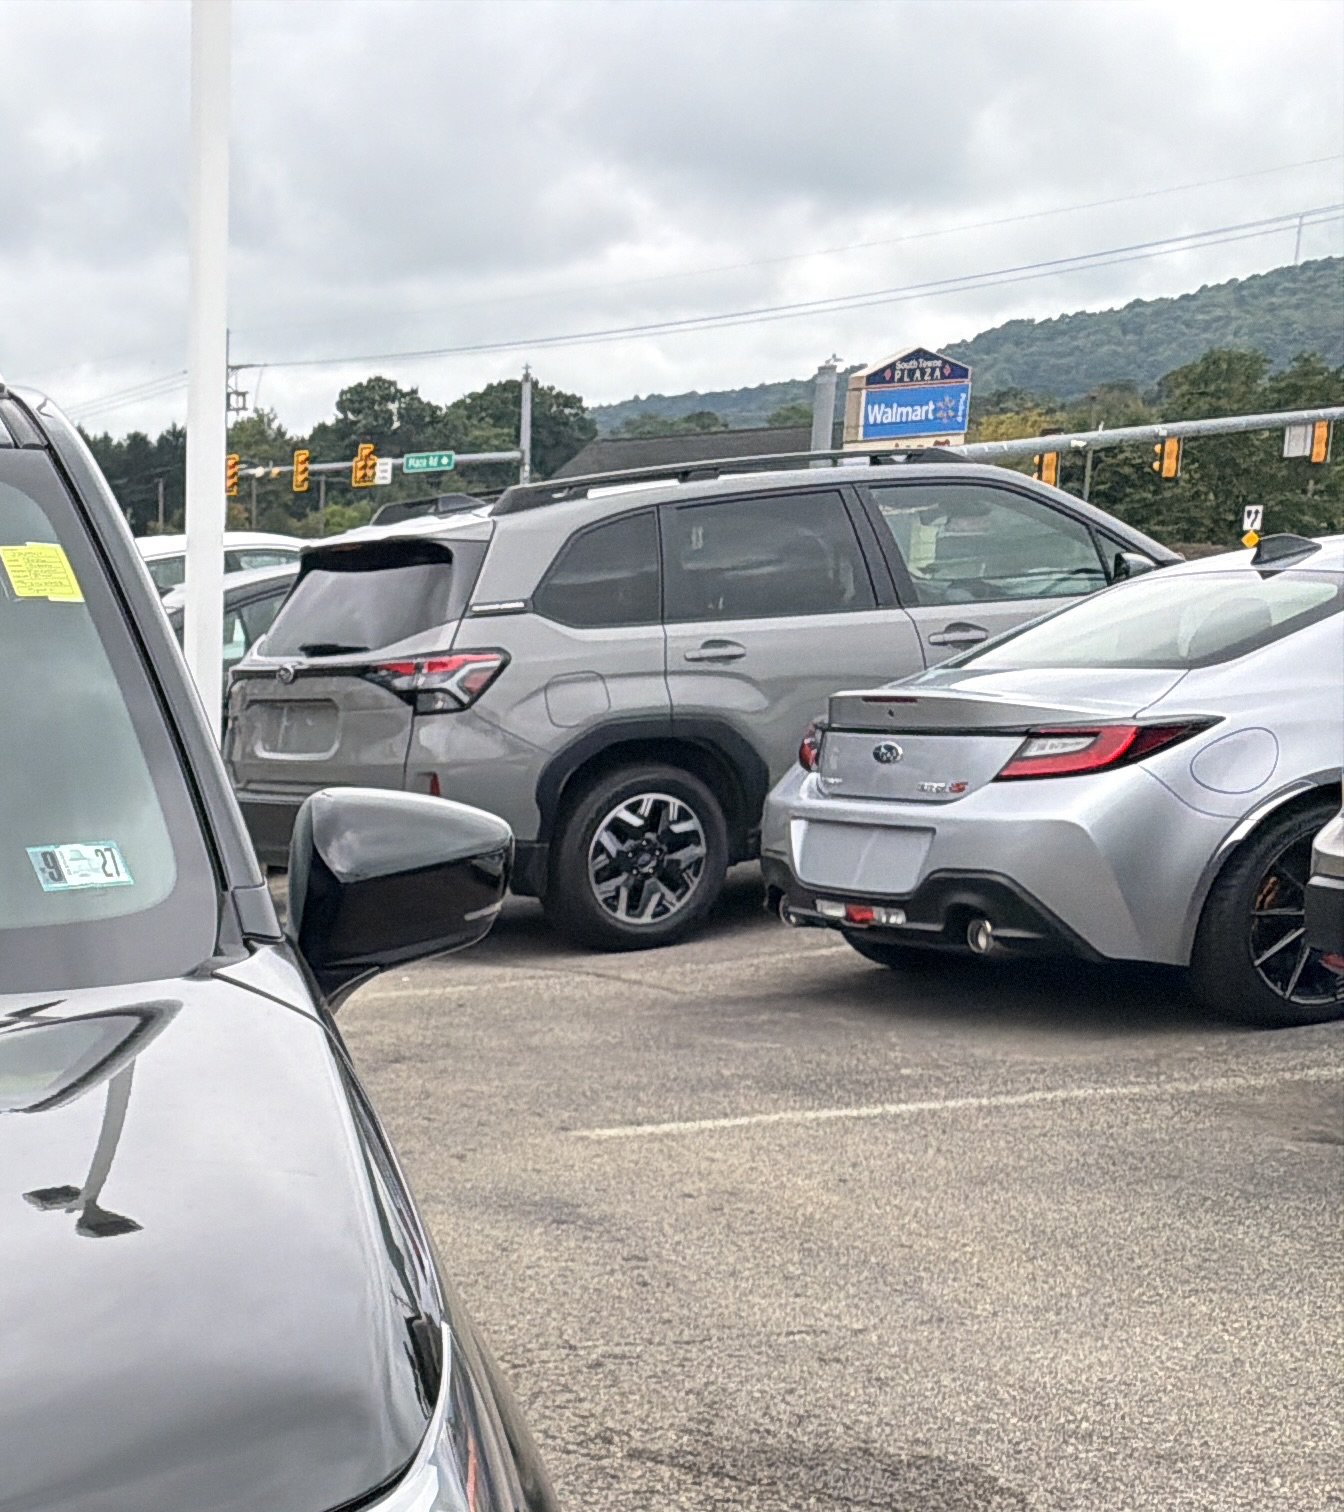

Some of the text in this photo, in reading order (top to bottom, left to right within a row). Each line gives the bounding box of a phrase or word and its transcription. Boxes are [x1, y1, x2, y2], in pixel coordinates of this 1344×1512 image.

[894, 367, 941, 383] PLAZA
[867, 400, 936, 425] Walmart
[94, 848, 121, 878] 27
